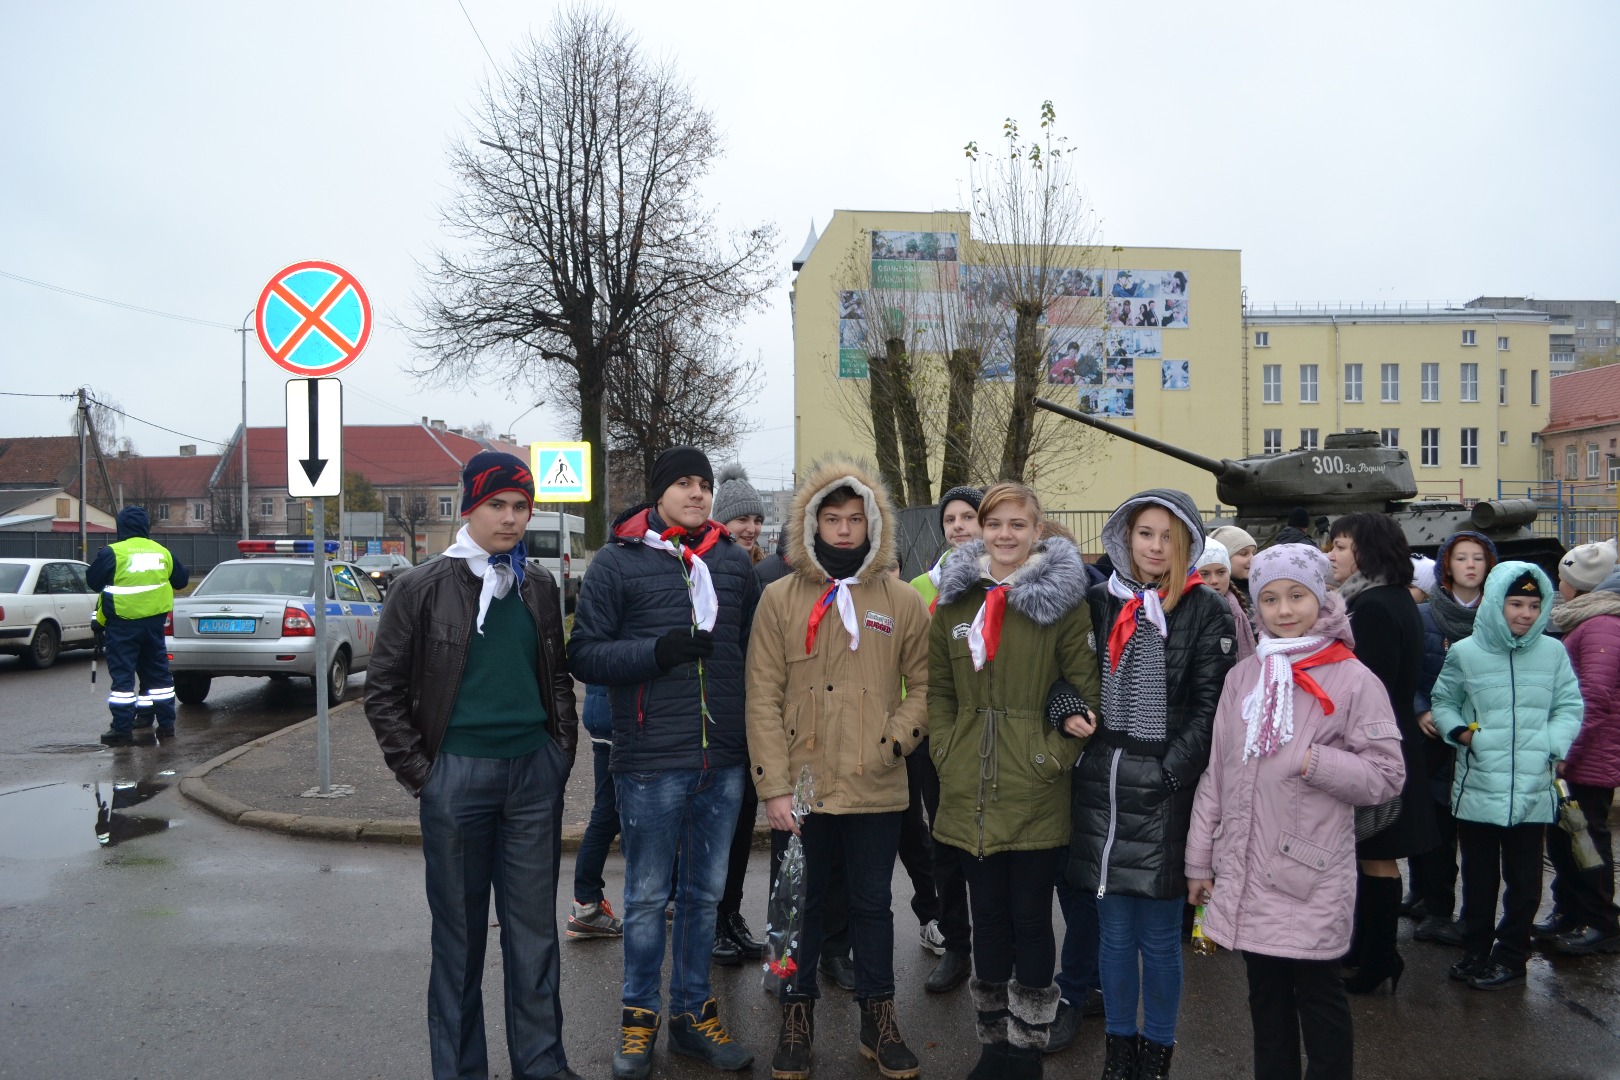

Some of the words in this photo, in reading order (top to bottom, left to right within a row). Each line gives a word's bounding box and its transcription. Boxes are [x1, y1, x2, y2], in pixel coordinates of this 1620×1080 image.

[1311, 455, 1344, 475] 300
[1344, 463, 1356, 474] За
[1358, 462, 1386, 474] Родину!
